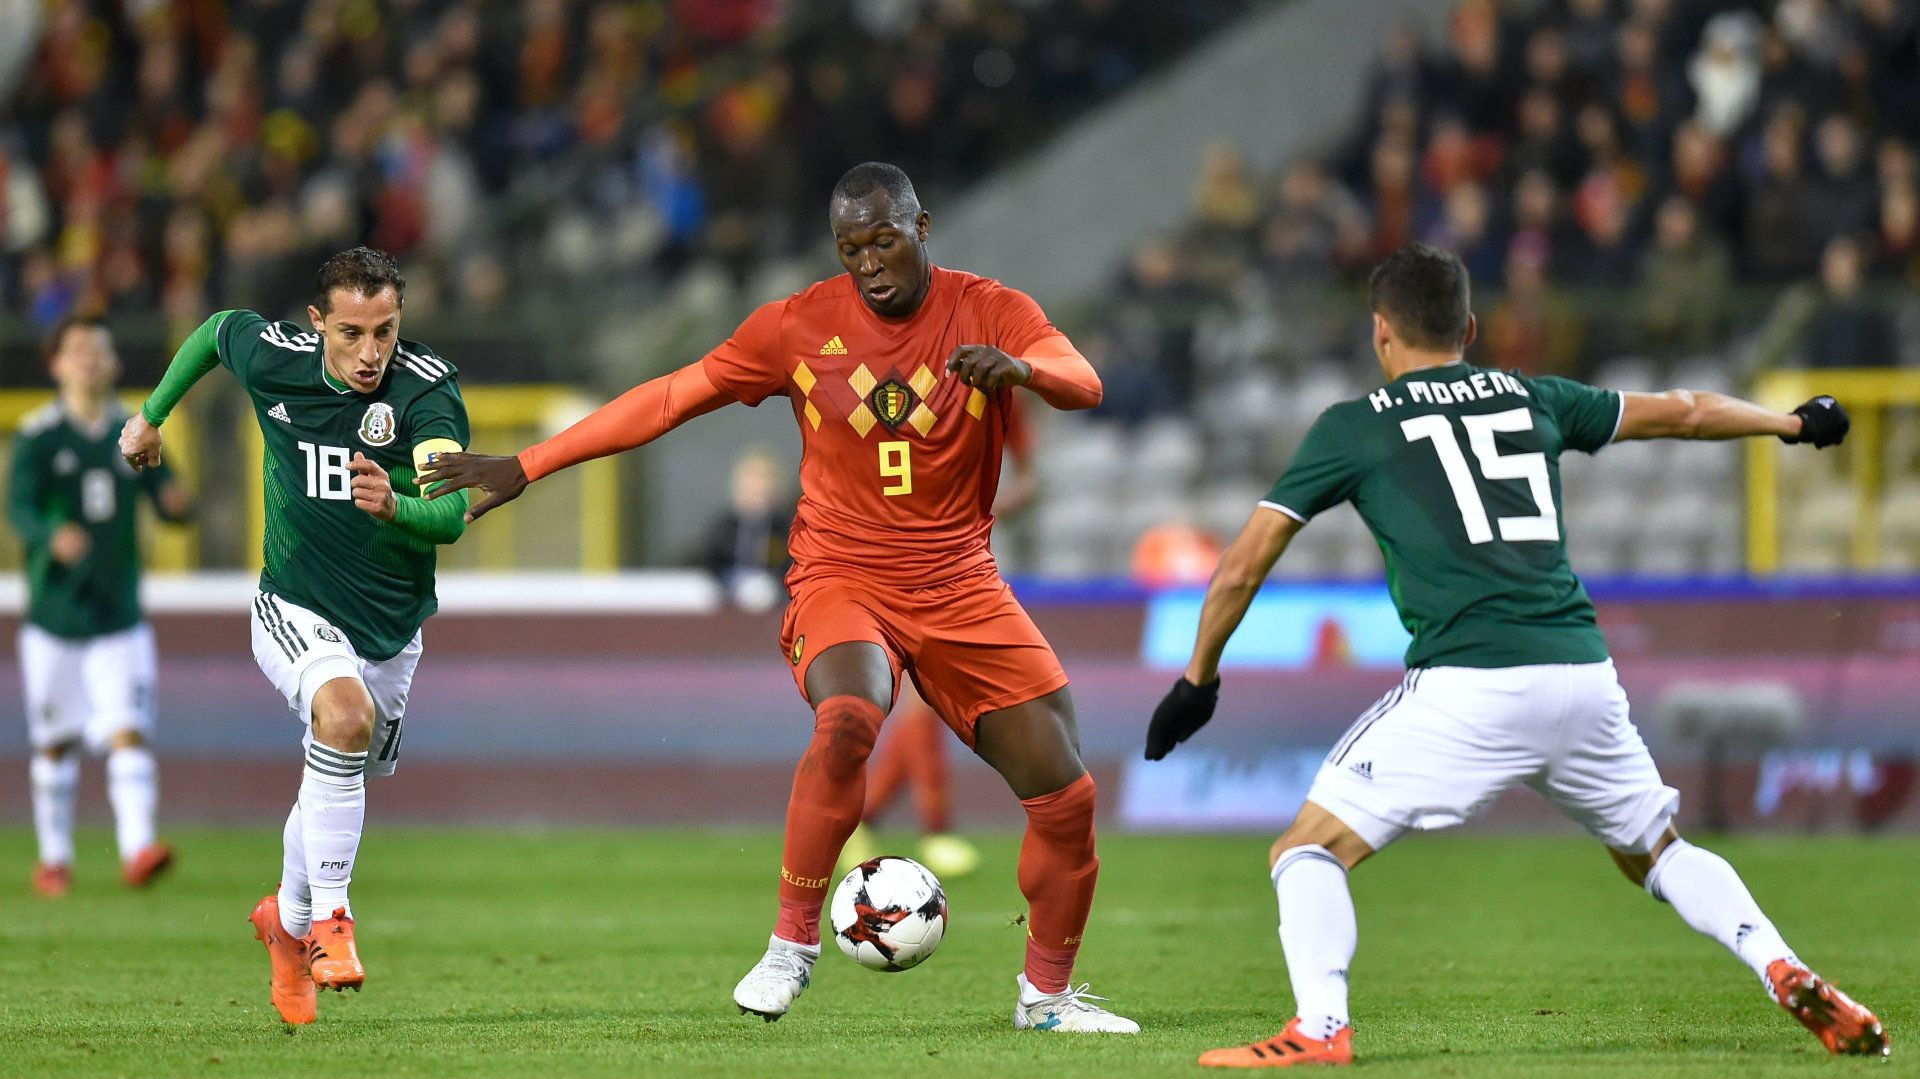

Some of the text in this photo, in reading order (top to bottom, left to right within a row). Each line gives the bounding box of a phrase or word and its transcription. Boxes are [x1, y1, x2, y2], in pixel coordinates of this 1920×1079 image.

[819, 347, 848, 355] adidas
[1368, 371, 1530, 413] H. MORENO
[267, 409, 292, 424] adidas
[297, 440, 352, 501] 18
[878, 441, 912, 496] 9
[1400, 406, 1560, 545] 15
[320, 860, 350, 871] FMF
[781, 865, 829, 889] BELGIUM
